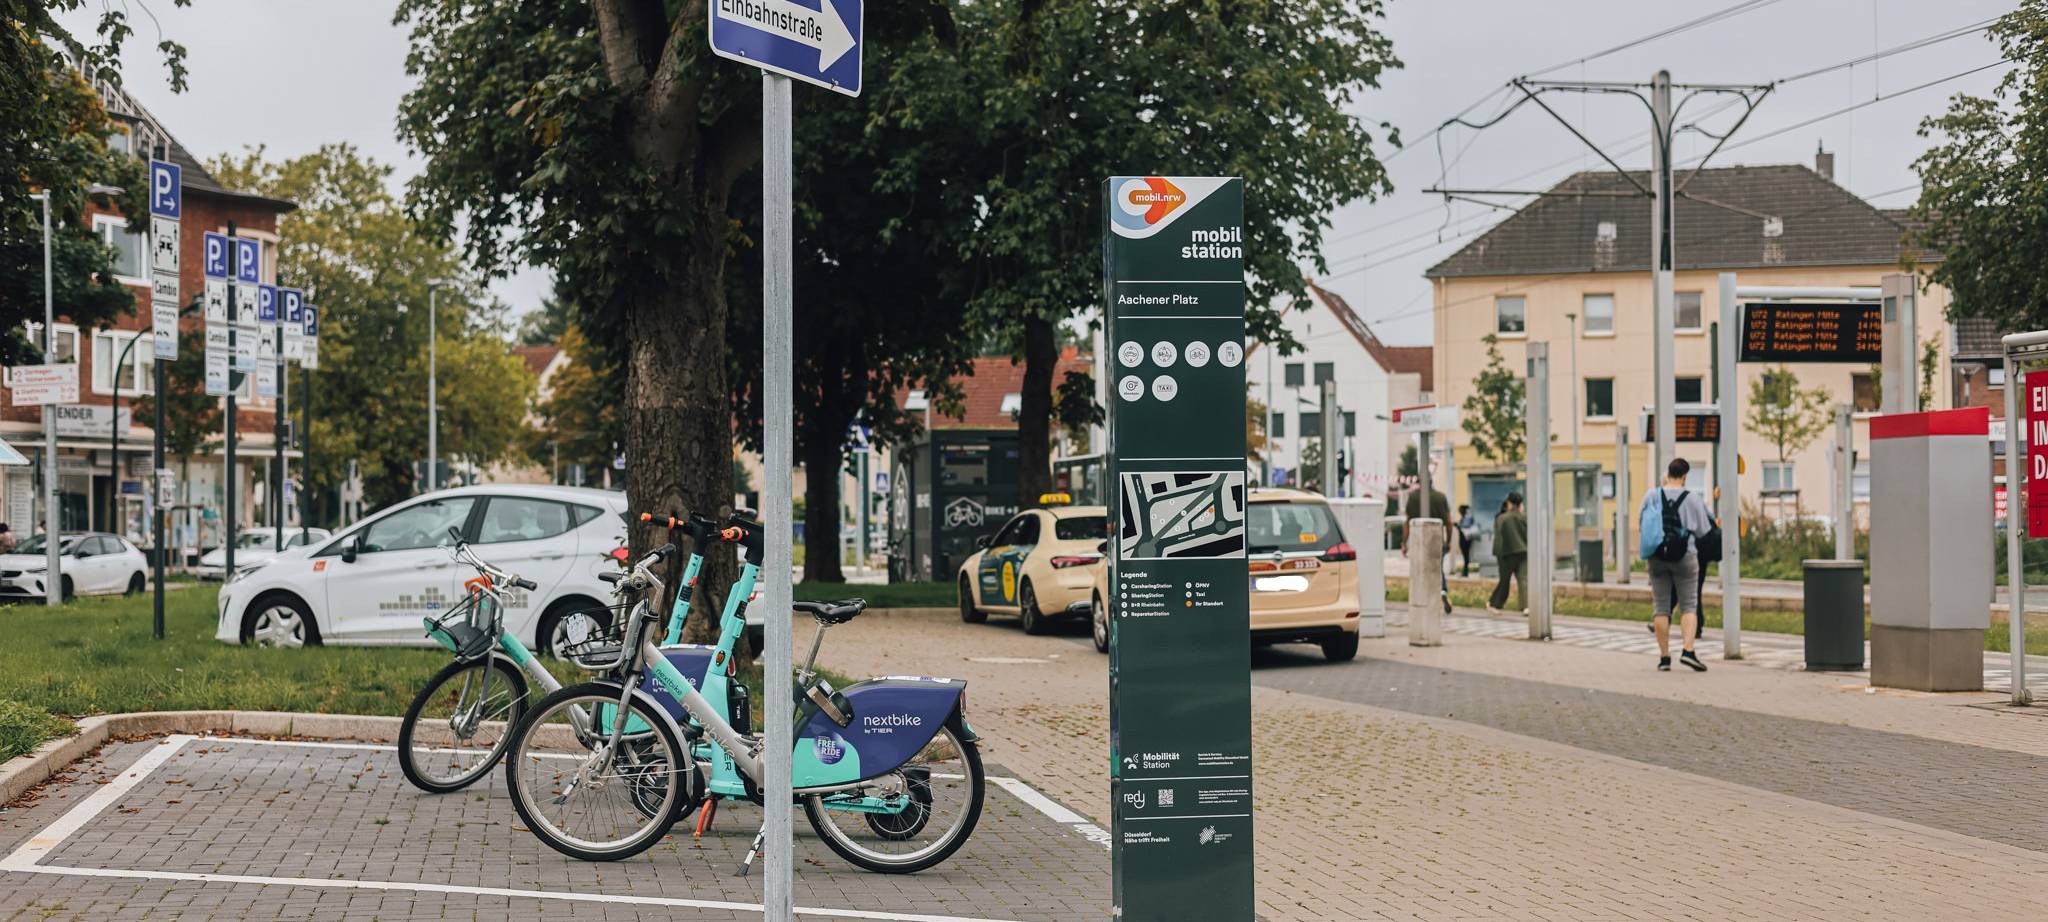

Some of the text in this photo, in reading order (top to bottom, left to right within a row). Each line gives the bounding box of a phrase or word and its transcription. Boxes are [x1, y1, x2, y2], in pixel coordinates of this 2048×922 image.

[722, 0, 822, 42] Einbahnstraße
[155, 168, 172, 208] P
[1136, 193, 1182, 202] mobil.nrw
[1192, 226, 1242, 242] mobil
[208, 238, 222, 273] P
[1182, 243, 1242, 259] station
[240, 244, 253, 278] P
[260, 288, 271, 317] P
[286, 293, 298, 321] P
[1118, 294, 1198, 304] Aachener Platz
[305, 309, 314, 334] P
[1776, 310, 1814, 320] Ratingen
[1817, 310, 1840, 319] Mitte
[1775, 321, 1814, 331] Ratingen
[1774, 332, 1813, 341] Ratingen
[1816, 332, 1838, 340] Mitte
[1774, 342, 1812, 351] Ratingen
[2033, 386, 2048, 412] EI
[58, 407, 93, 419] ENDER
[2034, 454, 2048, 480] D
[864, 713, 921, 726] nextbike
[818, 740, 835, 748] FREE
[821, 747, 840, 756] RIDE
[1124, 790, 1145, 808] redy
